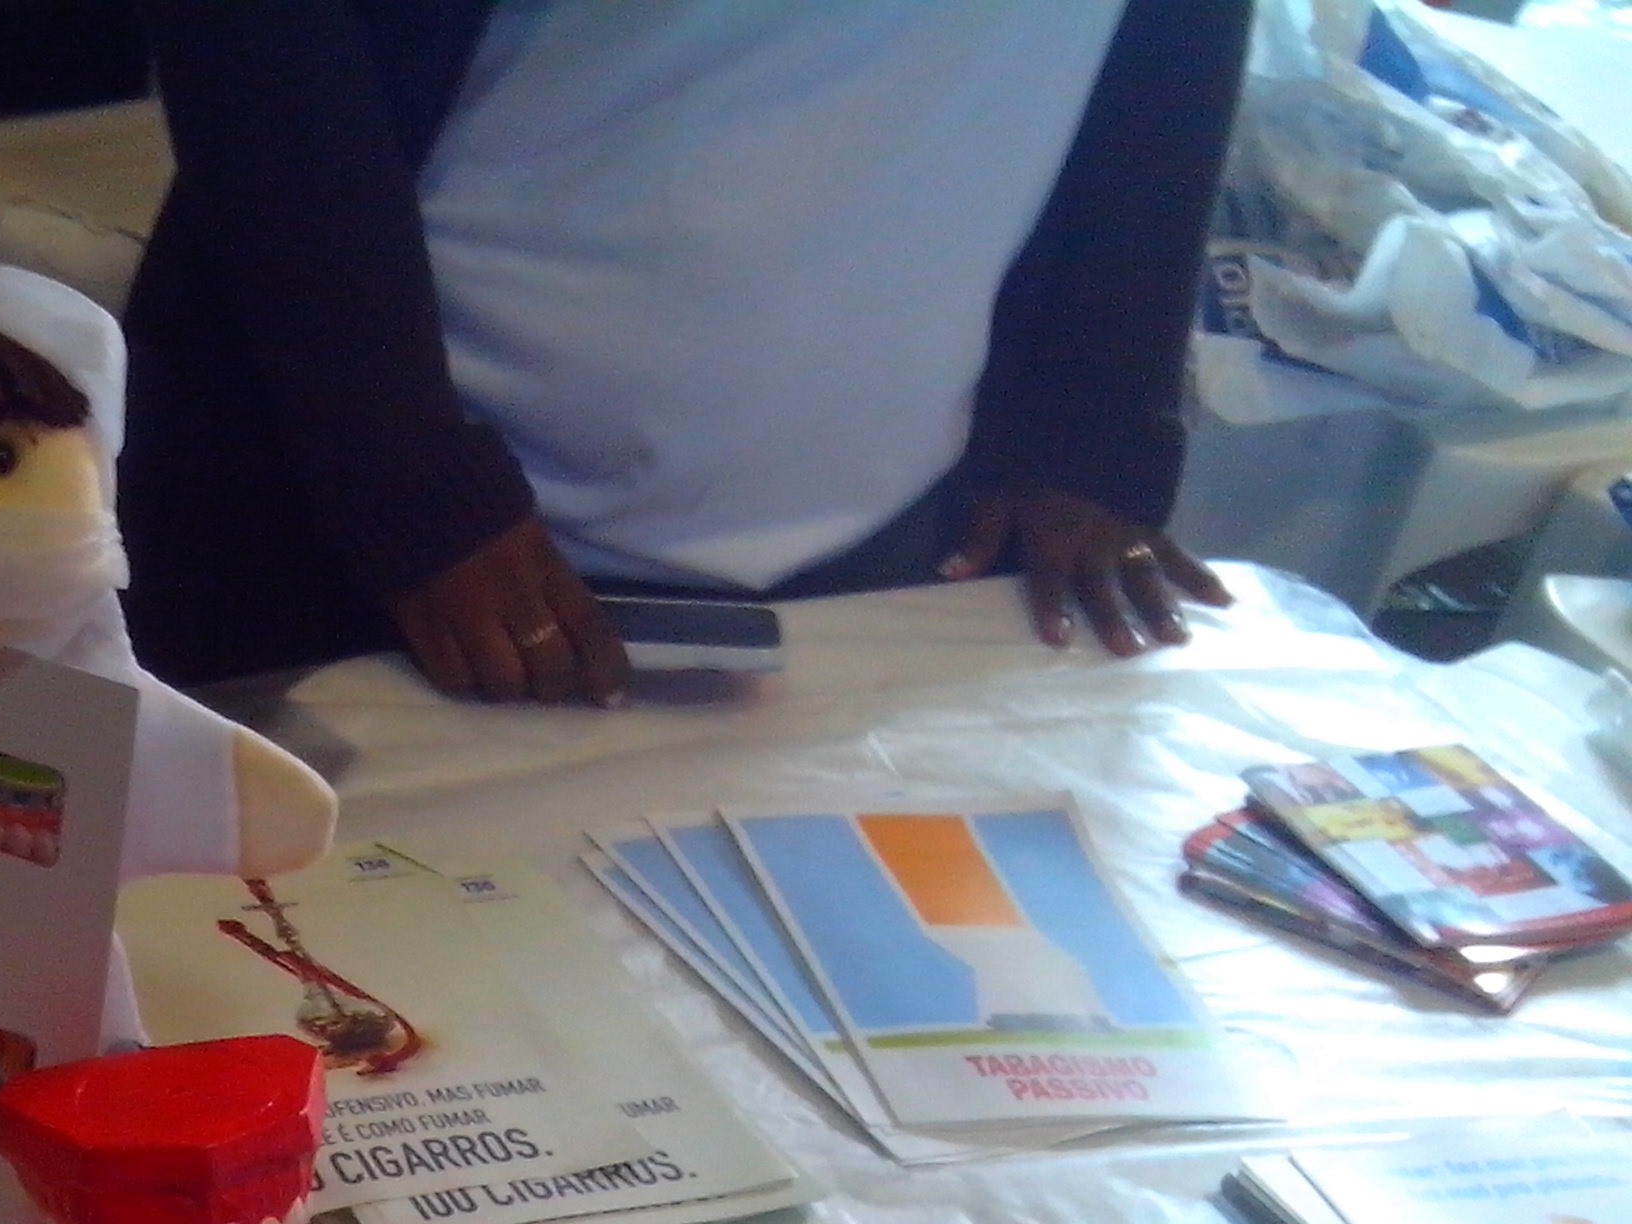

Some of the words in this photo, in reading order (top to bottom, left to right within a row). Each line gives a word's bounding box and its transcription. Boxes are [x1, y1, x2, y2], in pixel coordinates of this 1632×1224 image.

[964, 1054, 1158, 1077] TABAGISMO
[425, 1086, 473, 1104] MAS
[472, 1078, 546, 1099] FUMAR
[1005, 1080, 1149, 1101] PASSIVO
[355, 1117, 417, 1141] COMO
[418, 1108, 491, 1131] FUMAR
[329, 1128, 554, 1185] CIGARROS.
